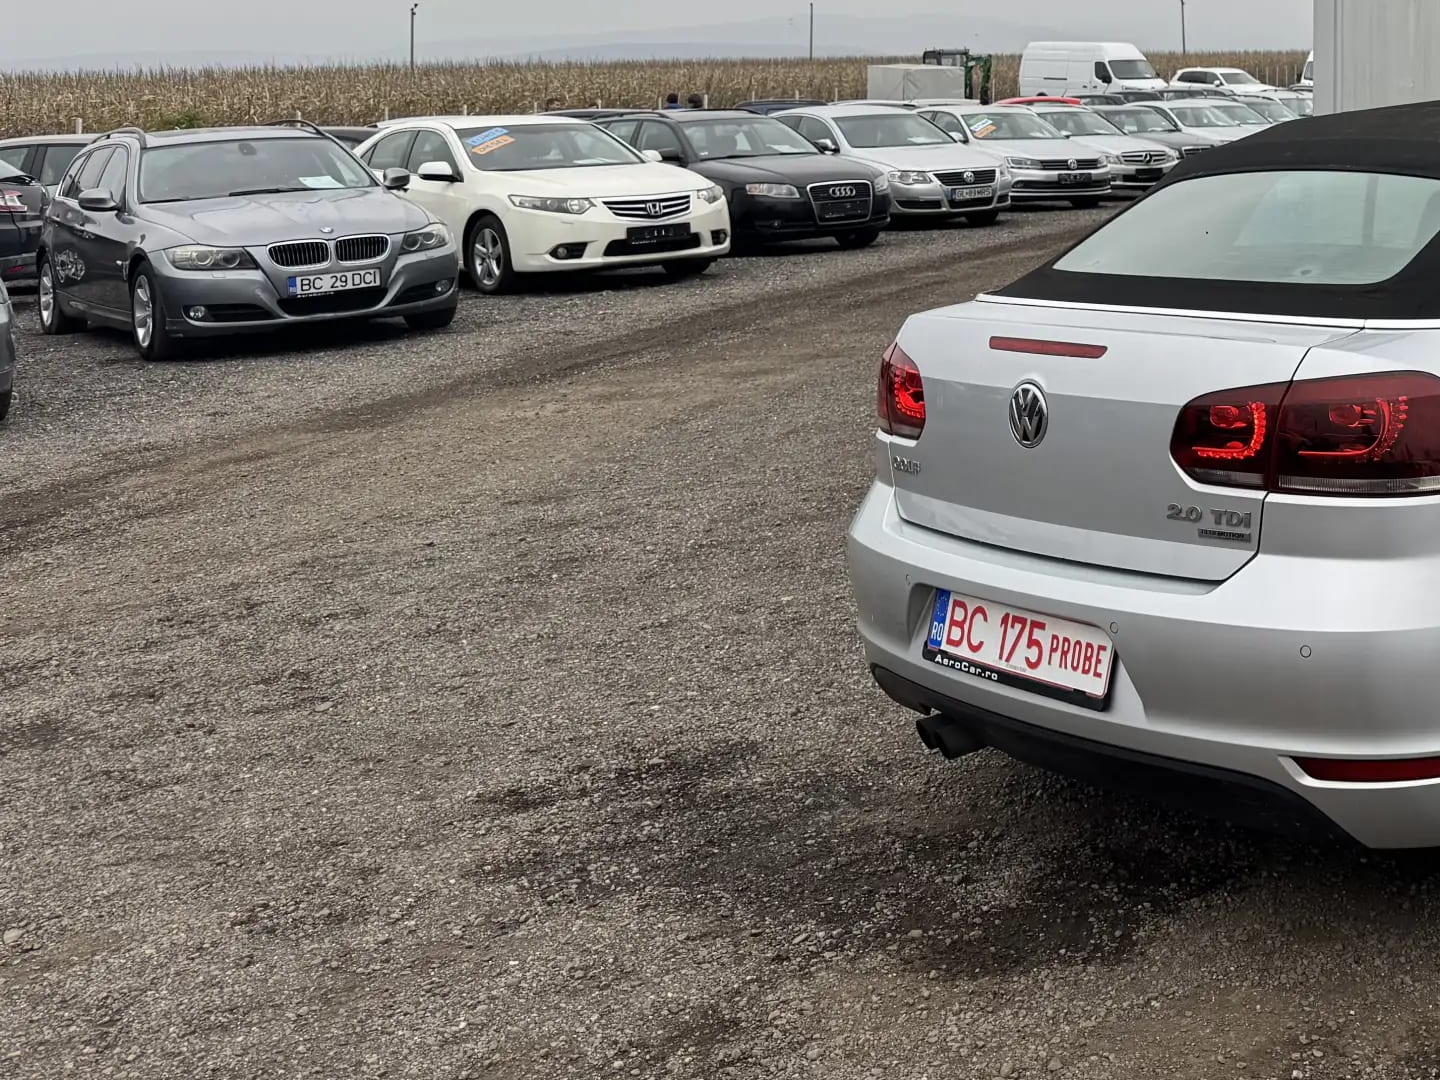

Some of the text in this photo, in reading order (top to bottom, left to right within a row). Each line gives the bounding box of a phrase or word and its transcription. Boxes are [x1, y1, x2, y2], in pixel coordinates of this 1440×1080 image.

[300, 277, 324, 291] BC
[330, 275, 348, 289] 29
[352, 271, 376, 286] DCI
[1166, 502, 1251, 528] 2.0 TDI
[931, 621, 944, 641] RO
[945, 599, 1107, 679] BC 175 PROBE
[934, 654, 998, 681] AeroCar.ro
